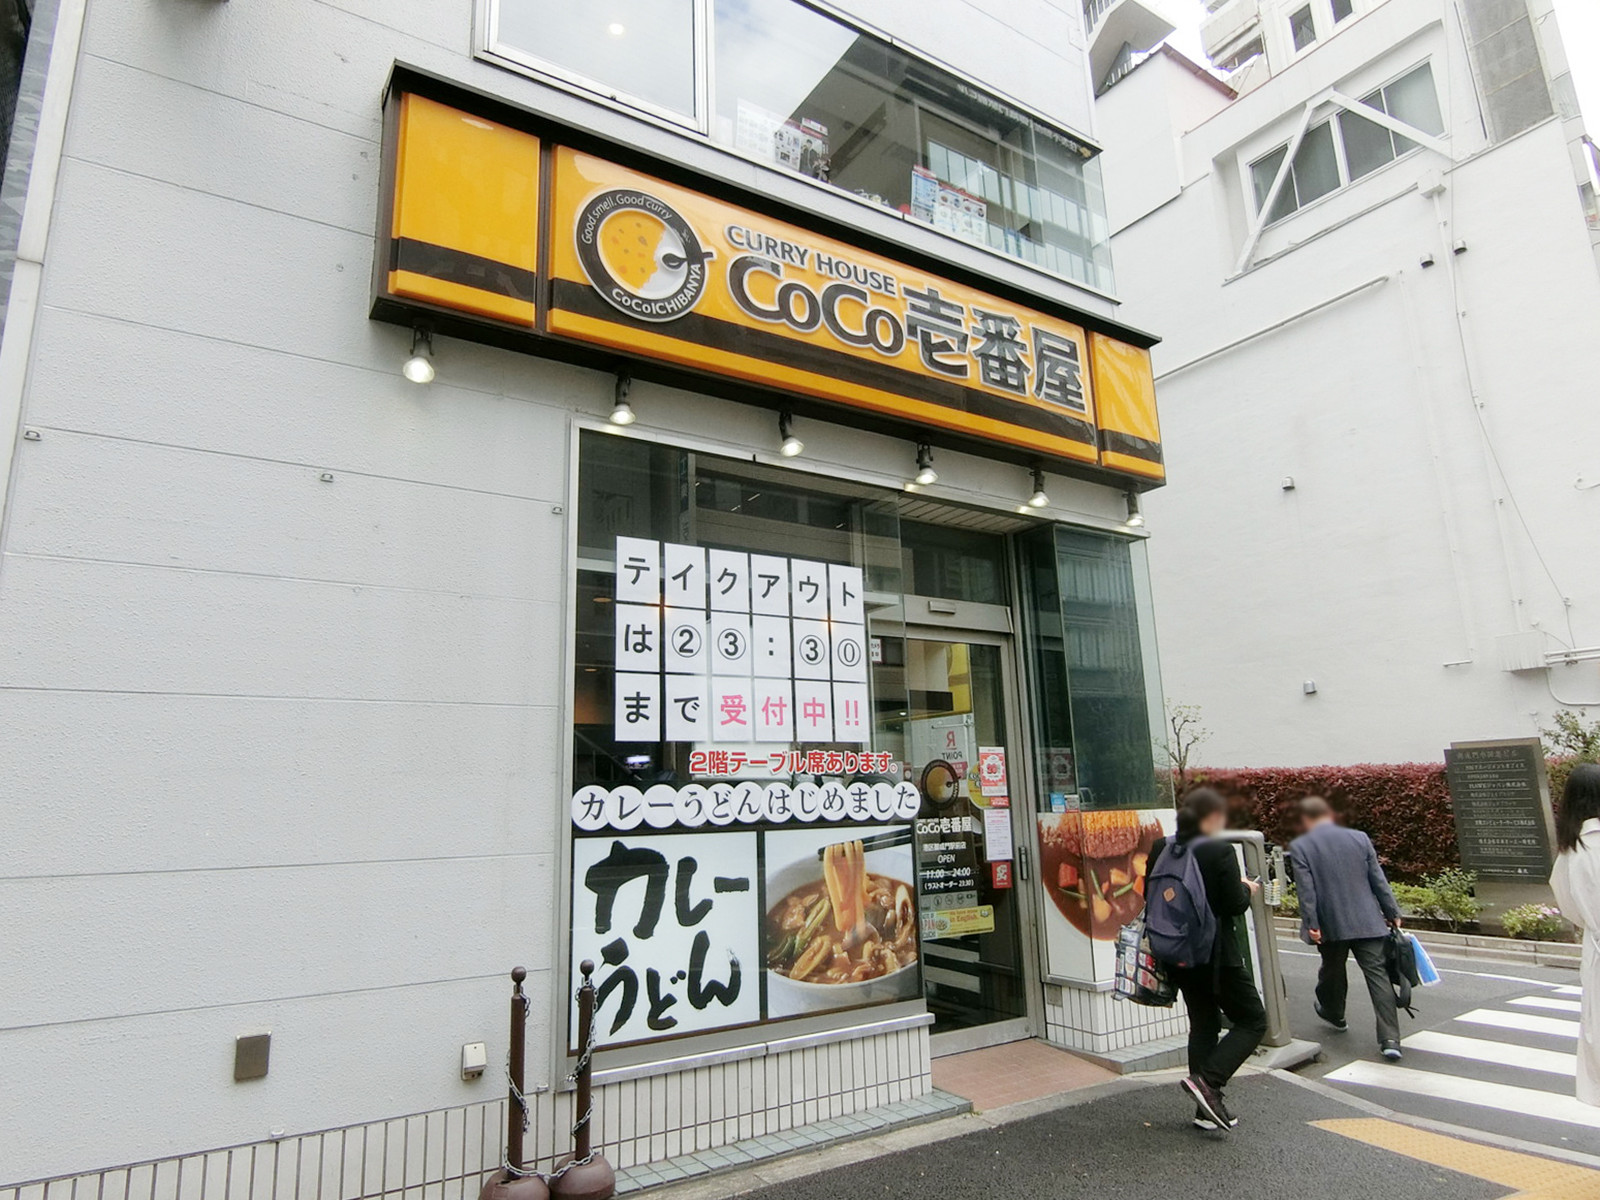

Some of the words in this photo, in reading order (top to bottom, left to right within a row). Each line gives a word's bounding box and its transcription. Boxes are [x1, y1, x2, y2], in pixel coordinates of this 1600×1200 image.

[581, 214, 597, 244] Good
[592, 196, 617, 219] smell.
[616, 193, 644, 207] Good
[645, 200, 673, 220] curry
[727, 225, 809, 267] CURRY
[816, 252, 896, 295] HOUSE
[611, 263, 701, 315] CoCoICHIBANYA
[728, 254, 1086, 413] CoCo壱番屋
[623, 556, 856, 607] テイクアウト
[689, 750, 898, 776] 2階テーブル席あります。
[579, 785, 917, 821] カレーうどんはじめました
[937, 853, 956, 864] OPEN
[584, 840, 750, 940] カレー
[596, 930, 742, 1036] うどん
